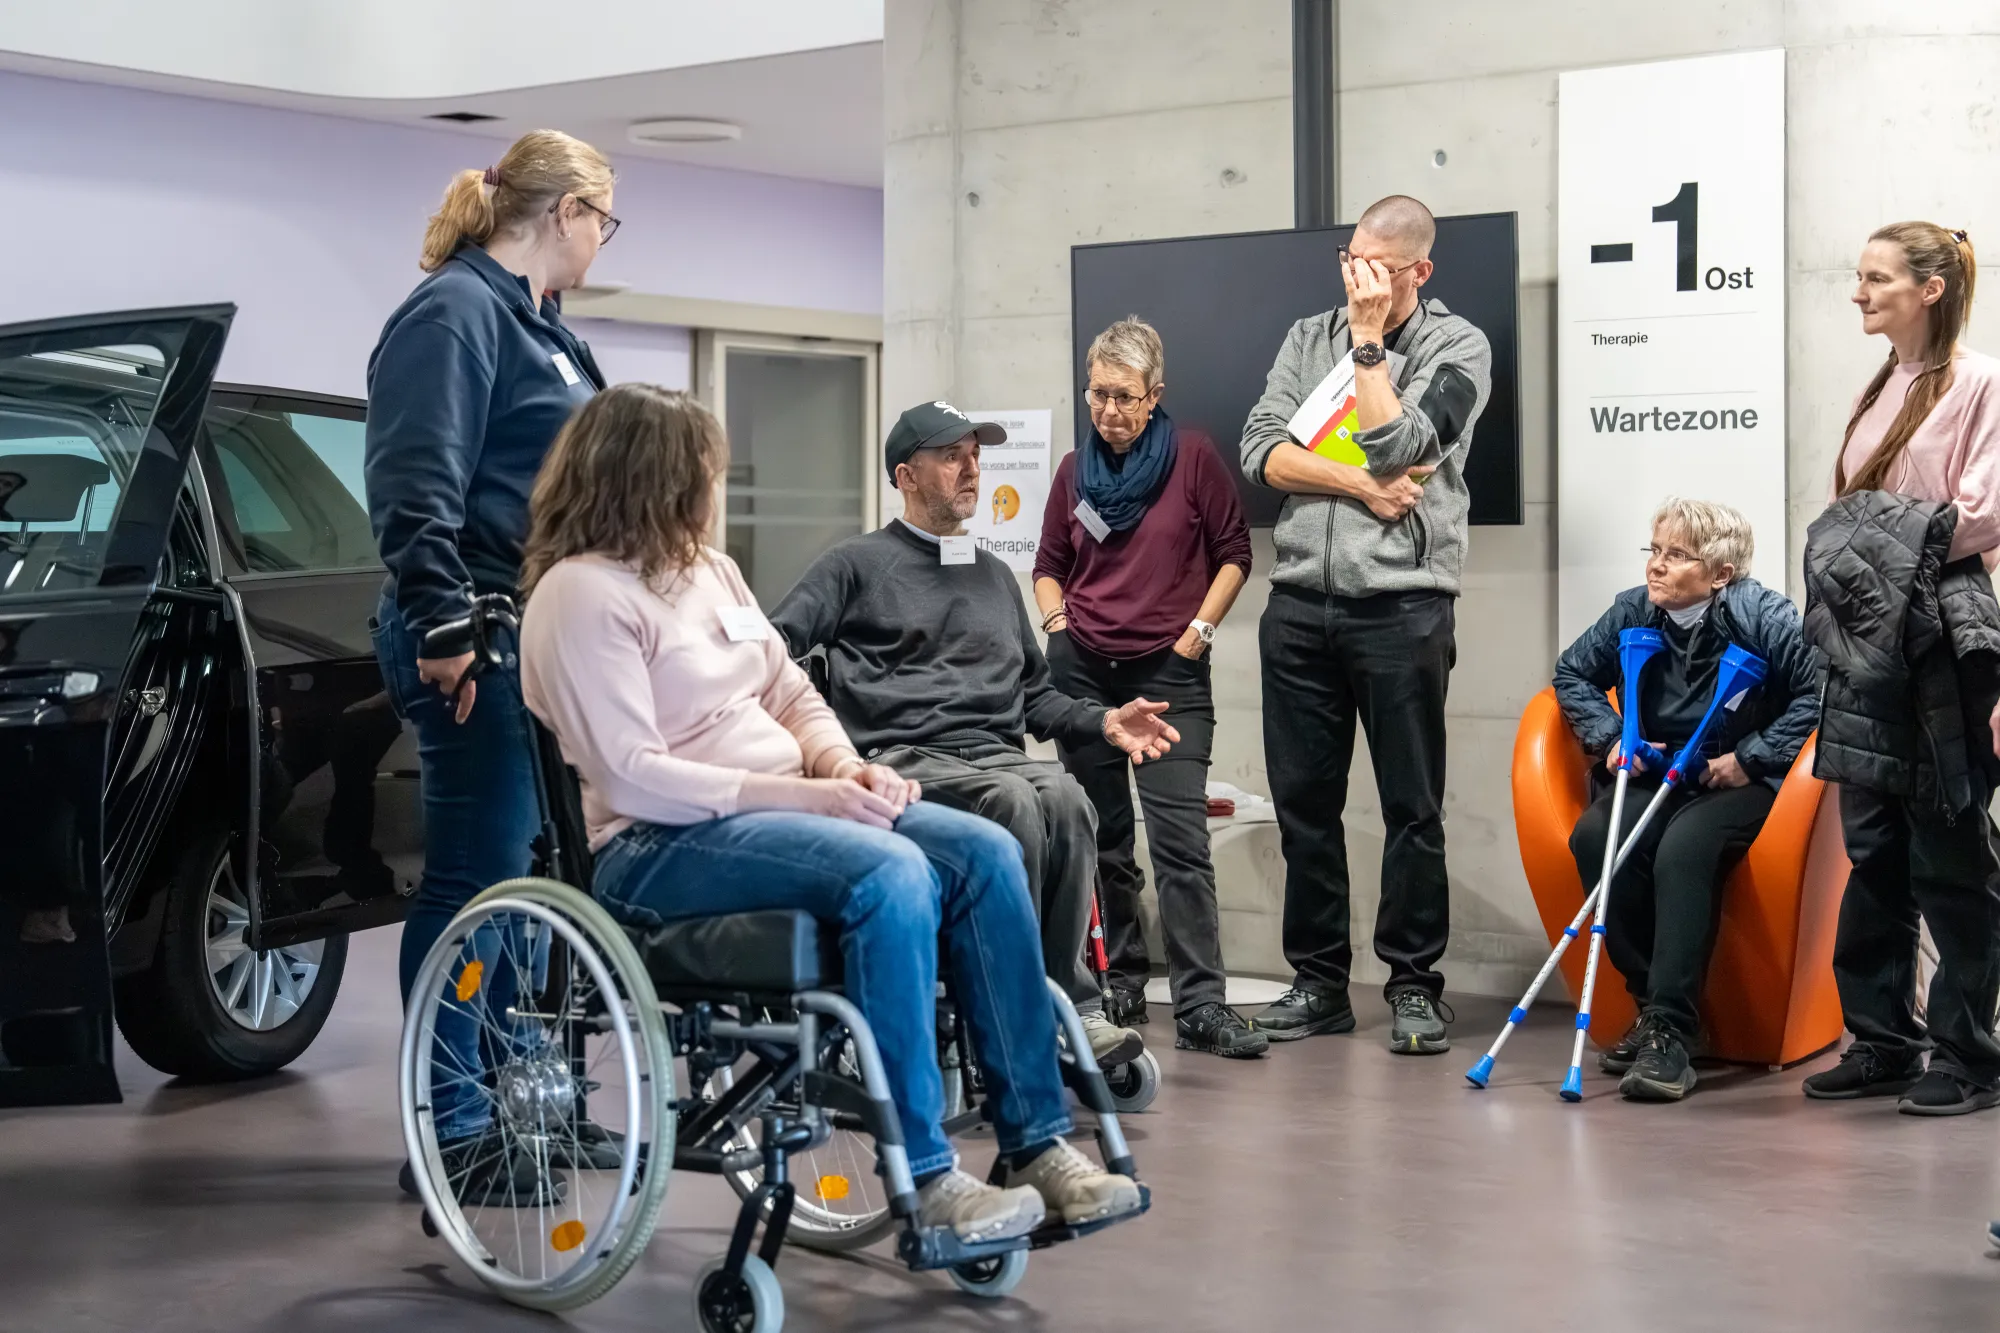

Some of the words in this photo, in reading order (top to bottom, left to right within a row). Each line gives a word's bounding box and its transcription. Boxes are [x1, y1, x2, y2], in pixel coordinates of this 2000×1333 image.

[1705, 267, 1754, 290] Ost
[1591, 332, 1648, 346] Therapie
[1590, 406, 1759, 433] Wartezone
[1006, 462, 1017, 470] per
[1019, 460, 1039, 469] favore
[977, 537, 1035, 555] Therapie
